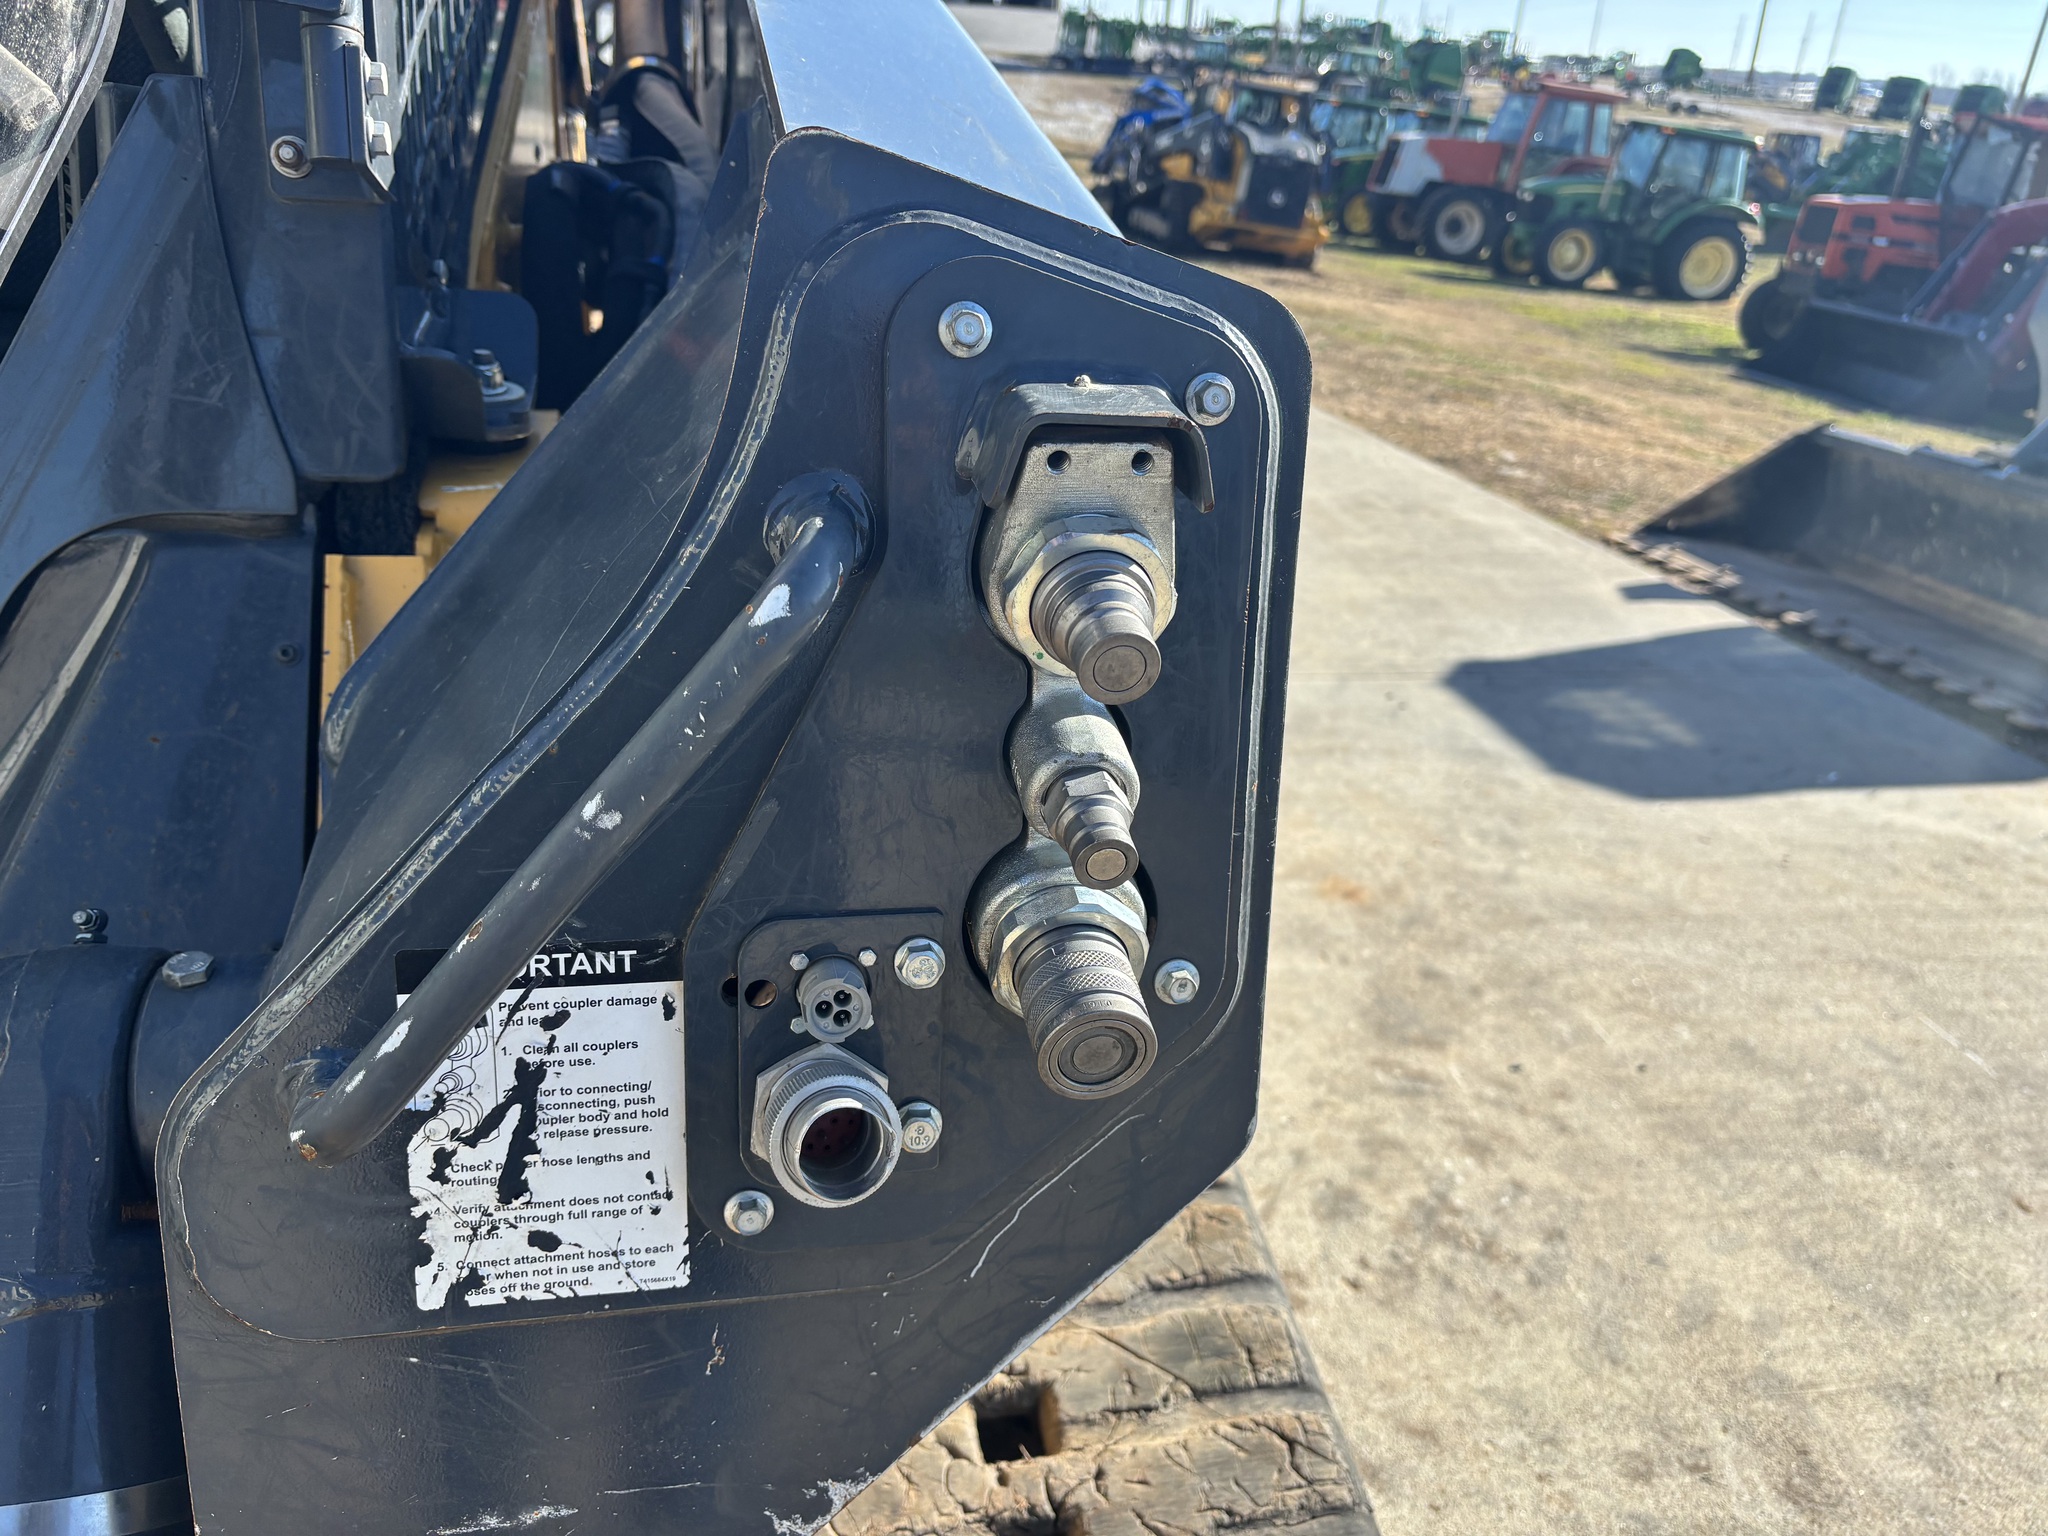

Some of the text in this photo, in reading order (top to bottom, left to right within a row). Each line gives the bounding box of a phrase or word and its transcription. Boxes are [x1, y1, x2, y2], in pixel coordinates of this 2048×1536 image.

[498, 996, 657, 1012] Prvent coupler damage
[501, 1046, 512, 1056] 1.
[563, 1042, 578, 1052] all
[582, 1040, 639, 1052] couplers
[569, 1058, 596, 1067] use.
[560, 1087, 573, 1096] to
[576, 1080, 652, 1094] connecting/
[624, 1094, 656, 1108] push
[578, 1111, 610, 1124] body
[614, 1109, 638, 1120] and
[641, 1107, 669, 1119] hold
[543, 1128, 589, 1139] release
[593, 1124, 653, 1138] pressure.
[450, 1161, 492, 1174] Check
[541, 1158, 573, 1168] hose
[576, 1153, 624, 1166] lengths
[627, 1150, 651, 1161] and
[452, 1203, 490, 1216] Verify
[568, 1196, 600, 1207] does
[603, 1194, 624, 1204] not
[453, 1204, 644, 1229] couplers through full range of
[454, 1231, 503, 1243] motion.
[437, 1243, 674, 1272] 5. Connect attachment hoss to each
[494, 1269, 529, 1280] when
[532, 1266, 553, 1277] not
[556, 1265, 568, 1275] in
[572, 1264, 594, 1274] use
[597, 1260, 621, 1271] and
[625, 1259, 656, 1270] store
[466, 1276, 593, 1297] oses off the ground.
